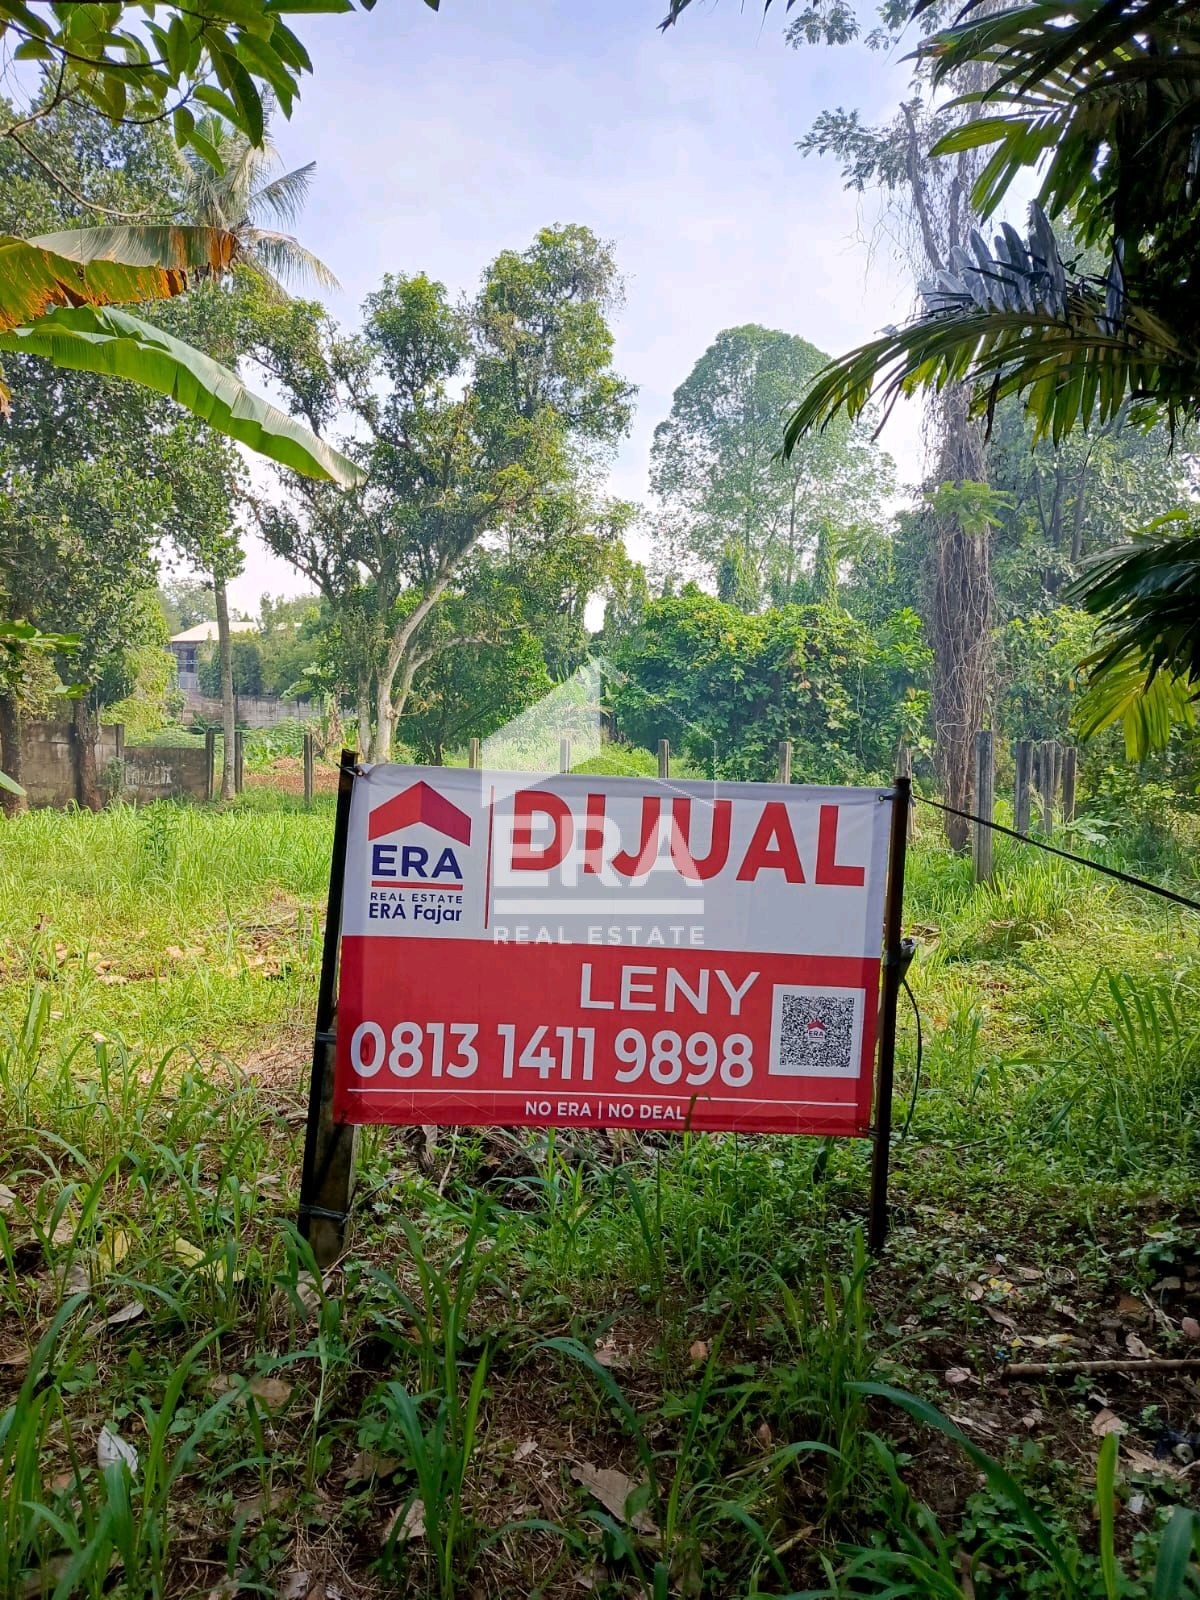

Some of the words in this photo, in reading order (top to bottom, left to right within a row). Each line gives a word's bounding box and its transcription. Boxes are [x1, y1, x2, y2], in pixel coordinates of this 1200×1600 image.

[511, 790, 865, 887] DIJUAL
[371, 844, 463, 880] ERA
[368, 902, 406, 920] ERA
[413, 904, 462, 925] Fajar
[370, 892, 405, 902] REAL
[411, 893, 463, 904] ESTATE
[580, 963, 760, 1016] LENY
[350, 1021, 479, 1078] 0813
[497, 1024, 596, 1081] 1411
[614, 1028, 753, 1087] 9898
[525, 1101, 552, 1116] NO
[557, 1102, 592, 1117] ERA
[608, 1103, 634, 1119] NO
[639, 1104, 687, 1120] DEAL
